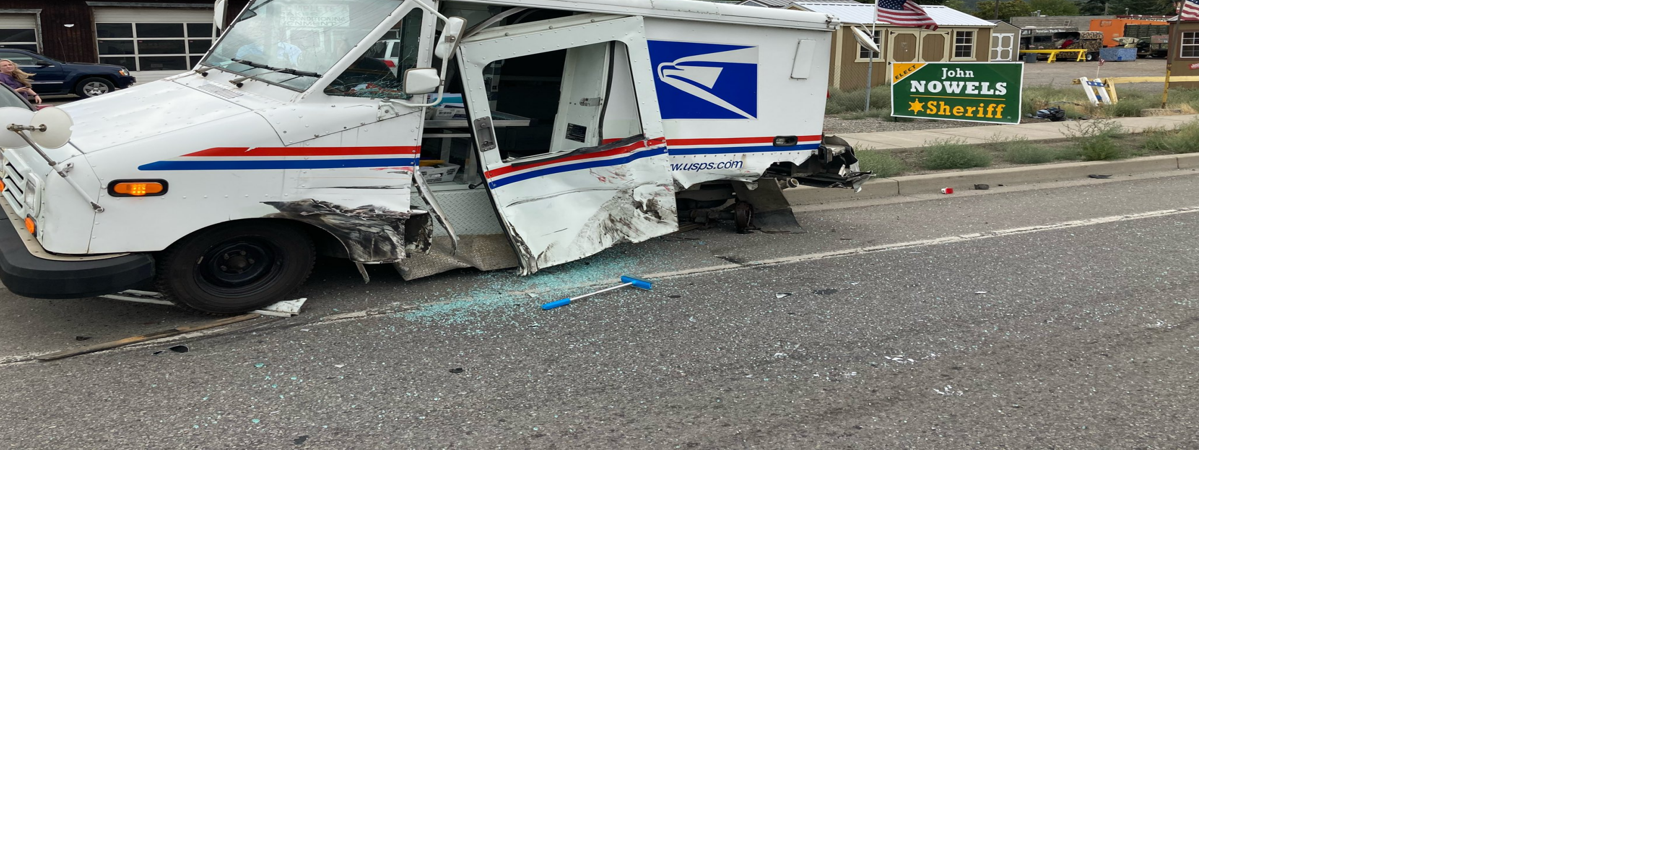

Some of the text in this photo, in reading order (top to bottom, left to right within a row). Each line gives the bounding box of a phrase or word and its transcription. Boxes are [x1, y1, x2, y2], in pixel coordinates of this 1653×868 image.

[894, 64, 917, 80] ELECT
[941, 67, 974, 79] John
[910, 80, 1007, 95] NOWELS
[926, 101, 1006, 118] Sheriff
[670, 160, 743, 172] w.usps.com
